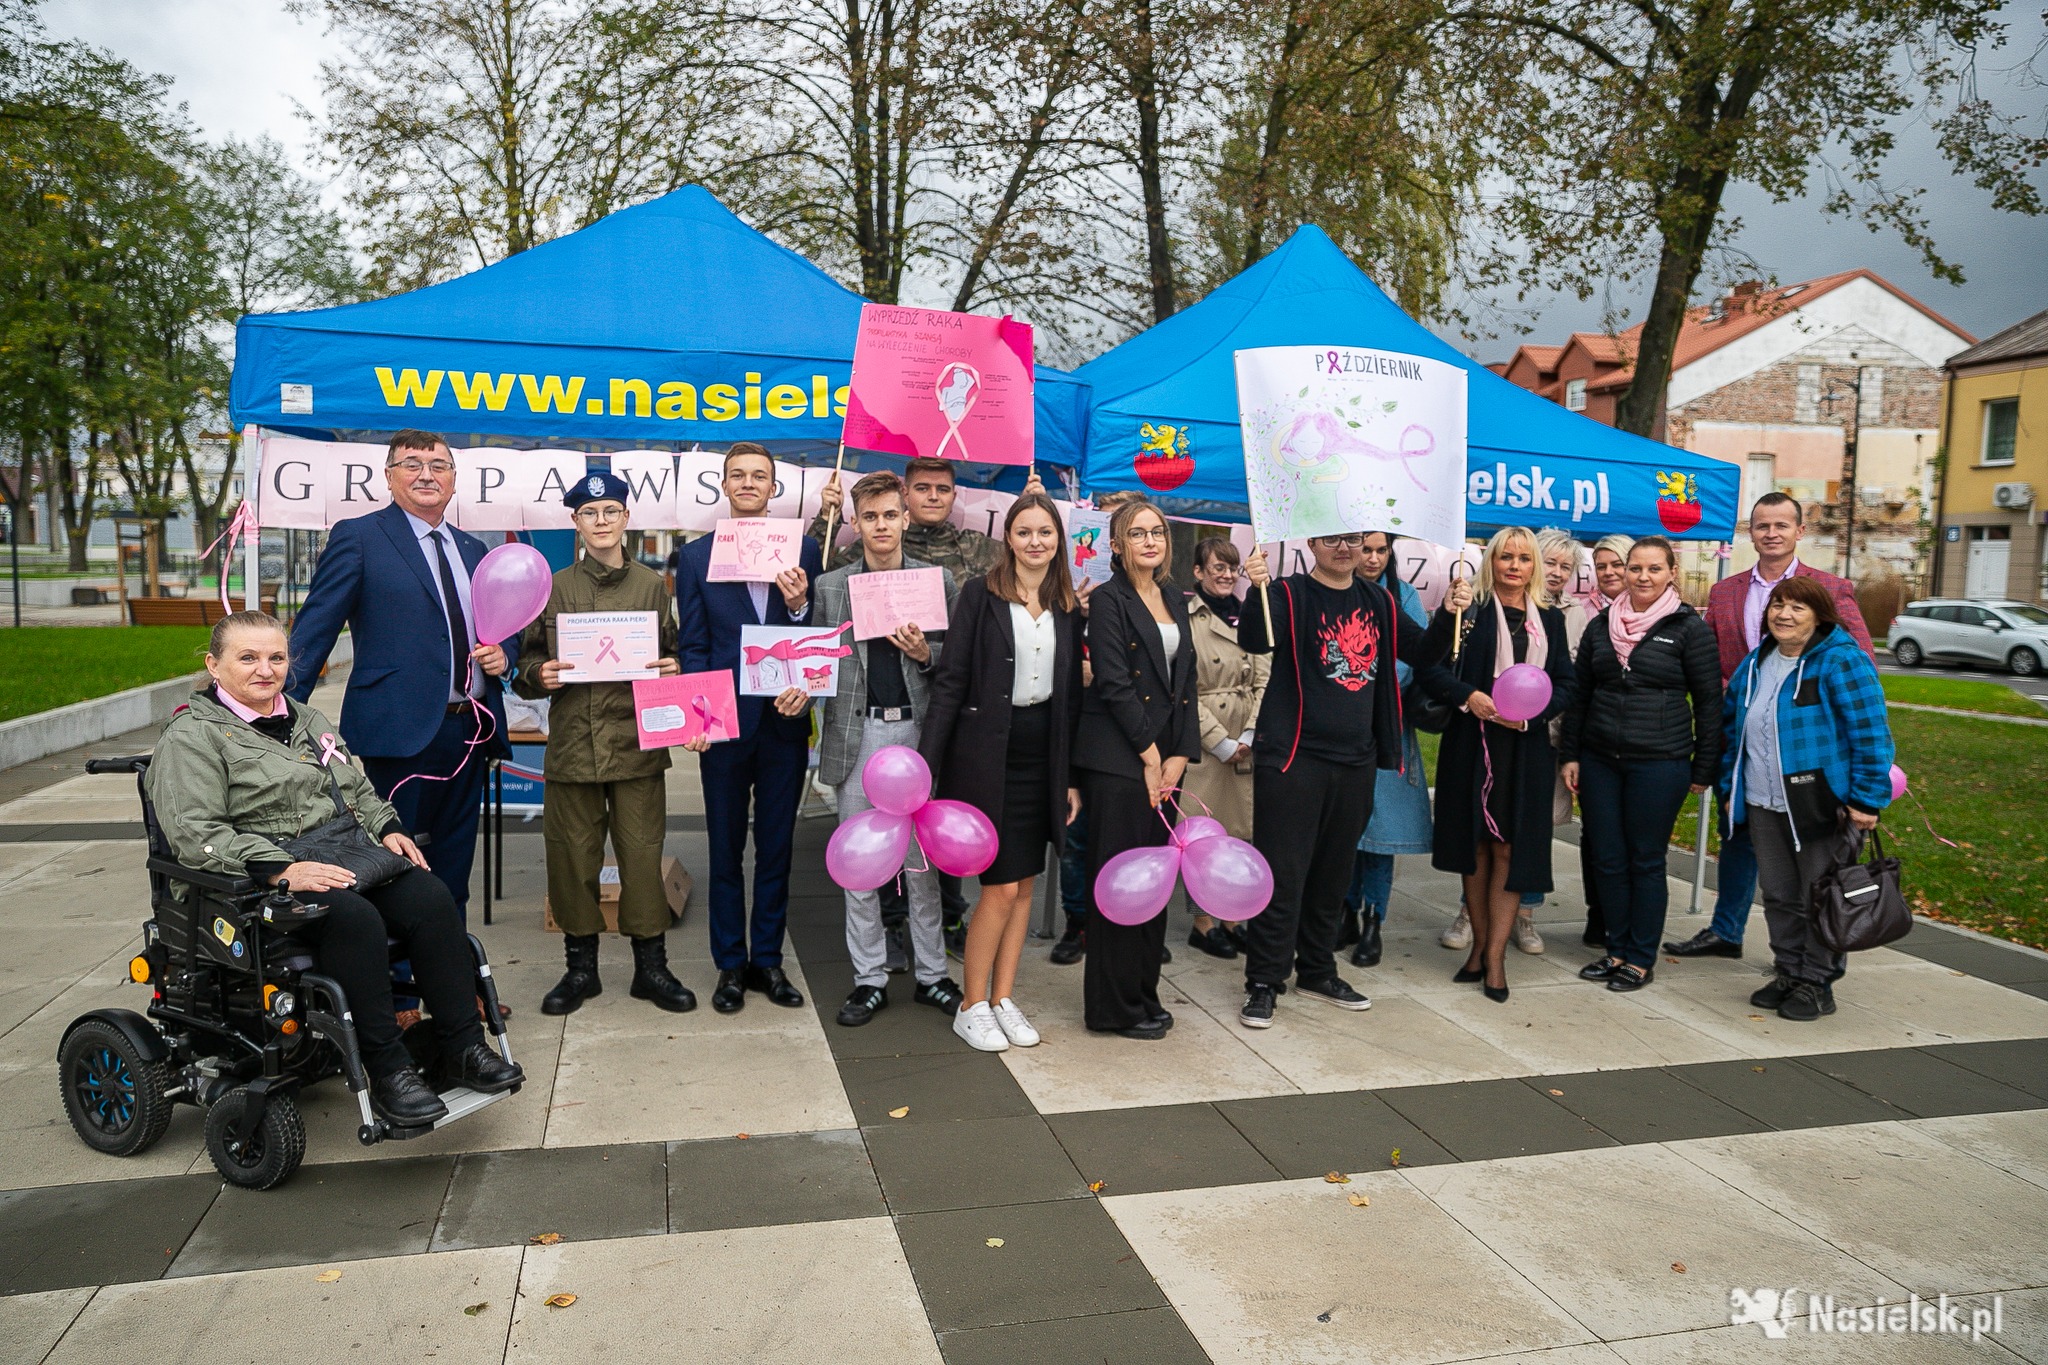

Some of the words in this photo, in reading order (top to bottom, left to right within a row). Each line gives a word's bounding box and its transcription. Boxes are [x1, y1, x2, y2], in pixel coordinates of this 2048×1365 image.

[868, 309, 920, 326] WYPRZEDŹ
[925, 312, 963, 330] RAKA
[935, 345, 973, 359] CHOROBY
[273, 461, 567, 504] GRPA
[1468, 462, 1610, 522] elsk.pl
[717, 534, 735, 543] RAKA
